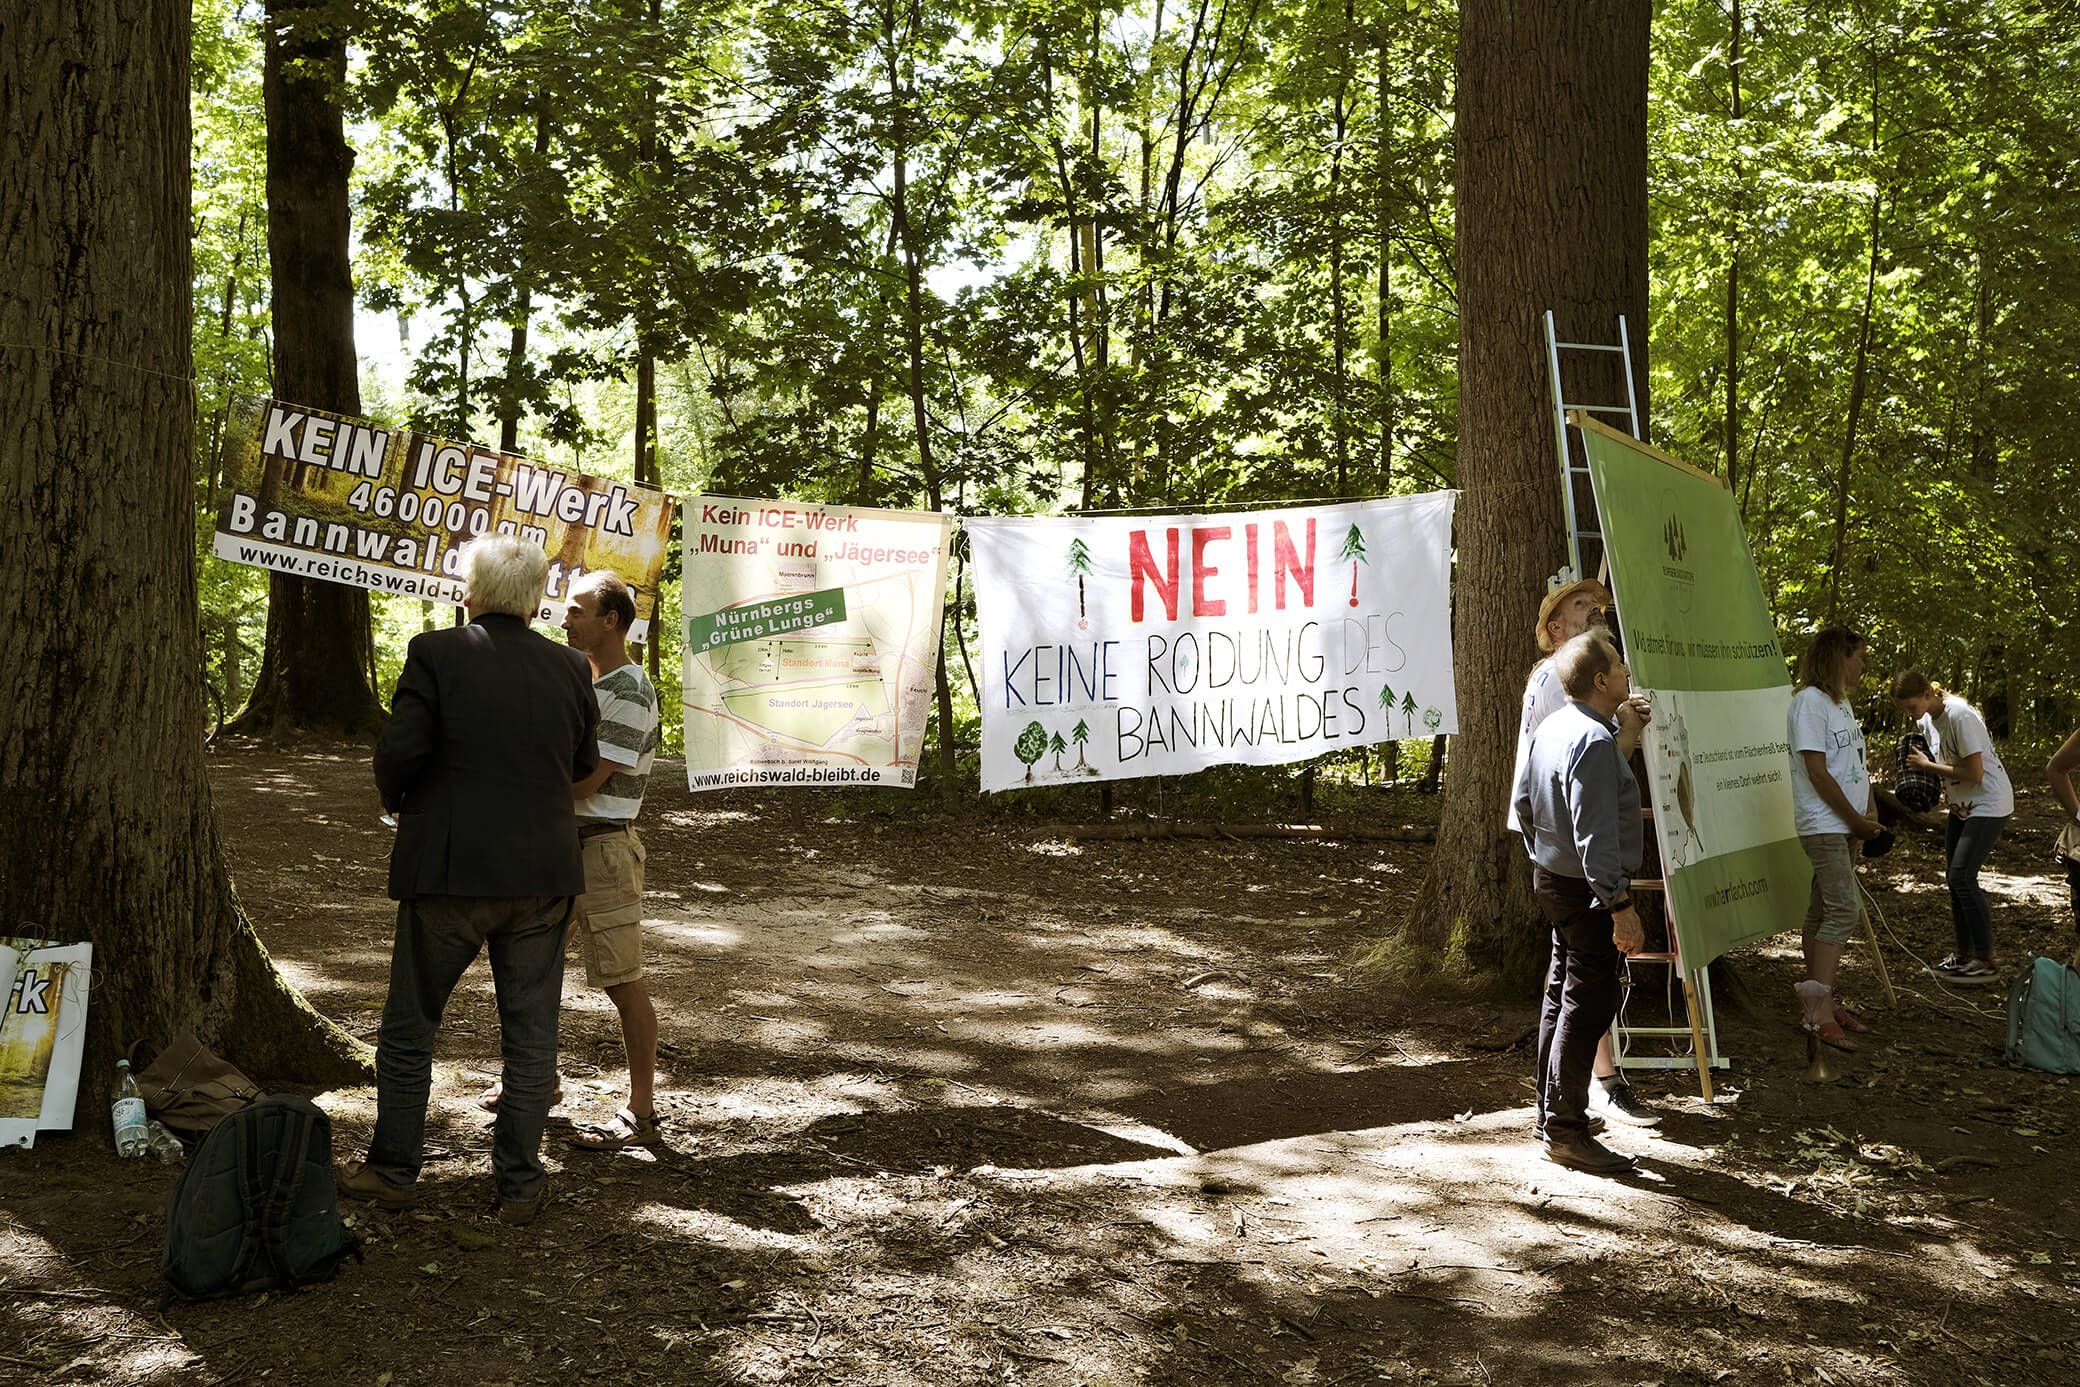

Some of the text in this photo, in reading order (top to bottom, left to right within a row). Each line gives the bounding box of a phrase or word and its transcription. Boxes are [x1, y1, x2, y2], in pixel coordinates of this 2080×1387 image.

[261, 408, 640, 536] KEIN ICE-Werk
[348, 481, 490, 537] 460000
[702, 504, 858, 533] Kein ICE-Werk
[690, 534, 941, 567] „Muna“ und „Jägersee“
[240, 546, 552, 621] www.reichswald-be
[1128, 518, 1317, 623] NEIN
[701, 607, 833, 651] „Grüne Lunge“
[715, 597, 814, 628] Nürnbergs
[782, 658, 823, 668] Standort
[824, 658, 850, 668] Muna
[1004, 611, 1407, 709] KEINE RODUNG DES
[1731, 640, 1778, 660] schützen!
[768, 698, 854, 711] Standort Jägersee
[1116, 687, 1366, 763] BANNWALDES
[694, 767, 881, 786] www.reichswald-bleibt.de
